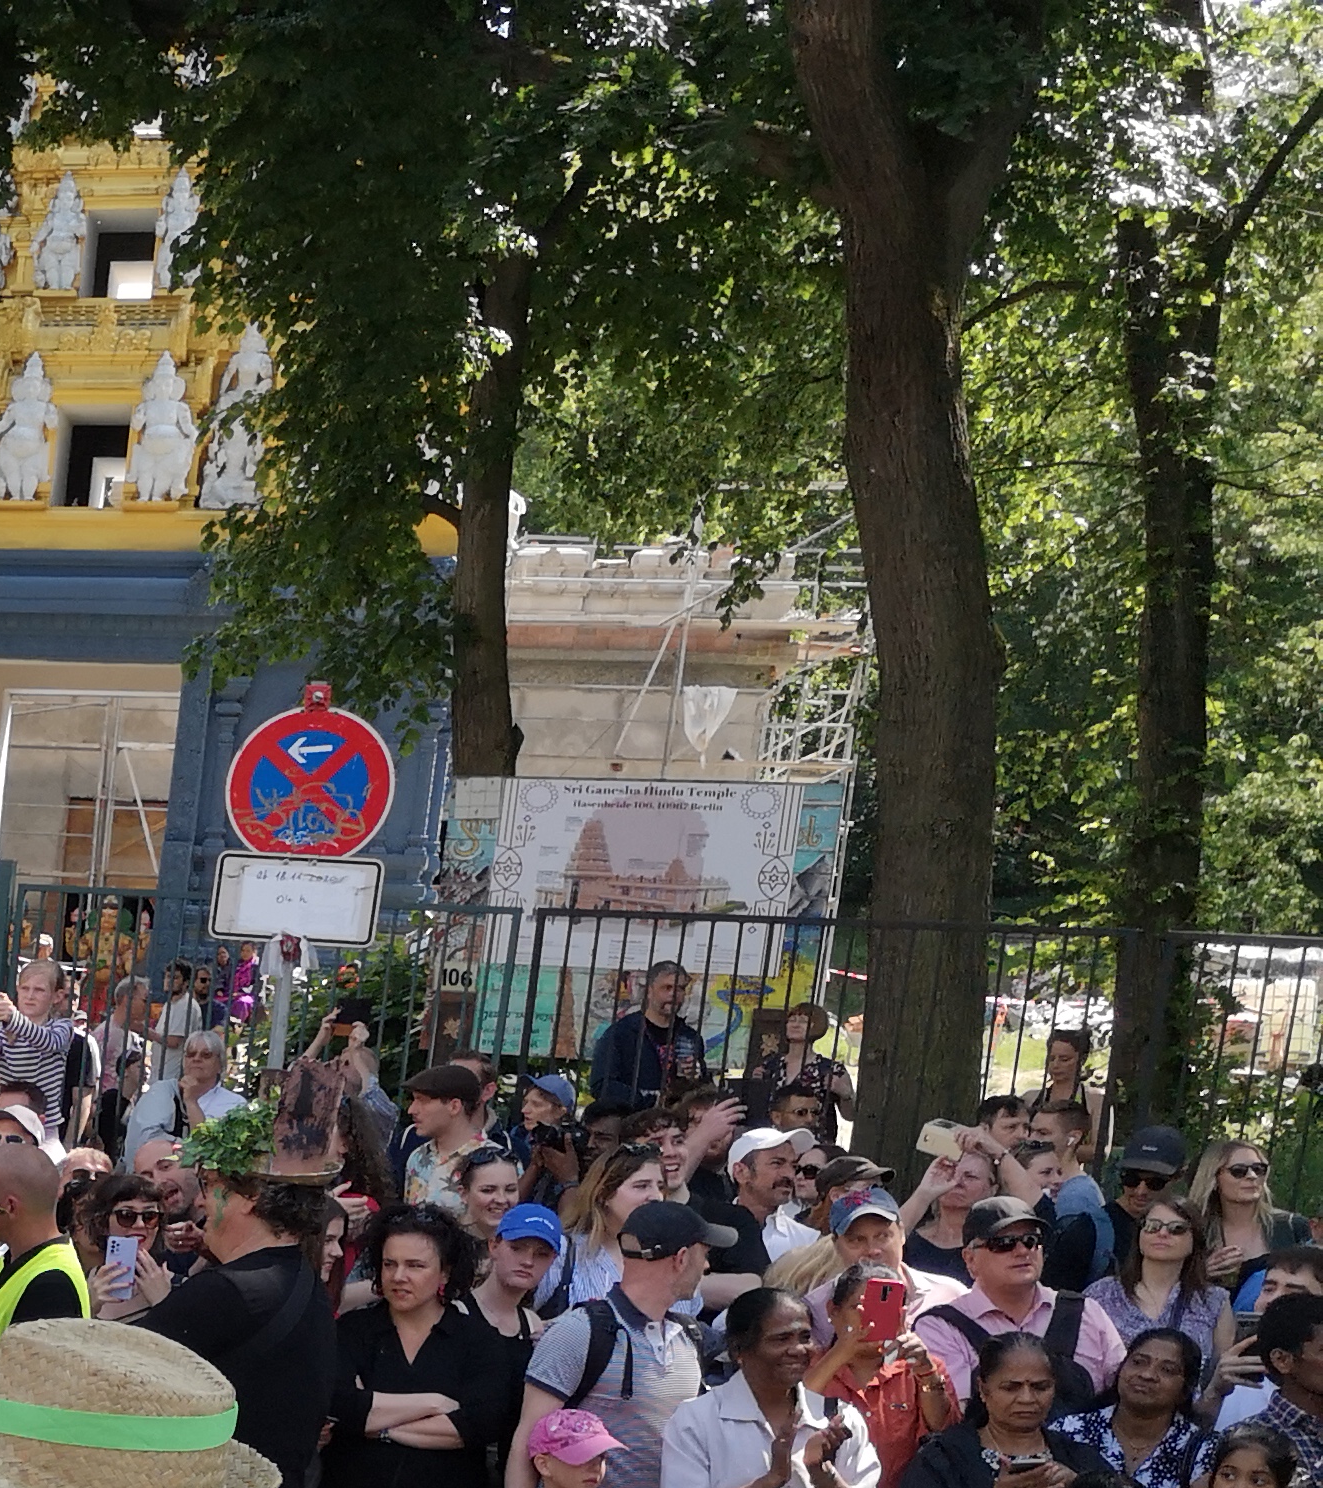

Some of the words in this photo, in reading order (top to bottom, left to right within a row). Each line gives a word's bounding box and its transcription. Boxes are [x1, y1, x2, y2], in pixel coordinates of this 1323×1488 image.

[563, 784, 583, 795] Sri
[585, 785, 641, 796] Ganesha
[643, 786, 684, 797] Hindu
[687, 787, 737, 800] Temple
[689, 803, 724, 812] Berlin
[441, 968, 473, 988] 106
